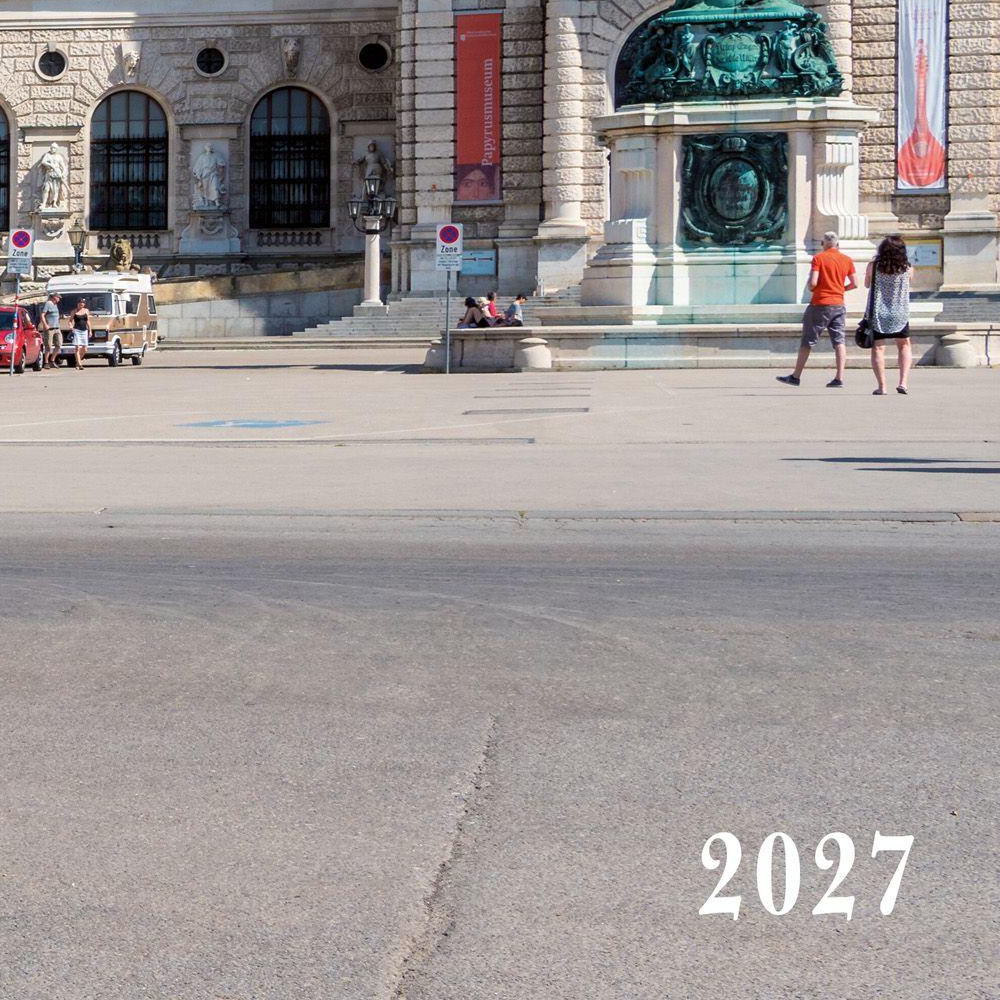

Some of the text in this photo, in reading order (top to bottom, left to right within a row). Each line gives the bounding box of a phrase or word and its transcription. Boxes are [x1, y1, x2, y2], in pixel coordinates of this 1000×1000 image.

[481, 59, 496, 166] Papyrusmuseum
[12, 249, 29, 257] Zone
[440, 245, 458, 254] Zone
